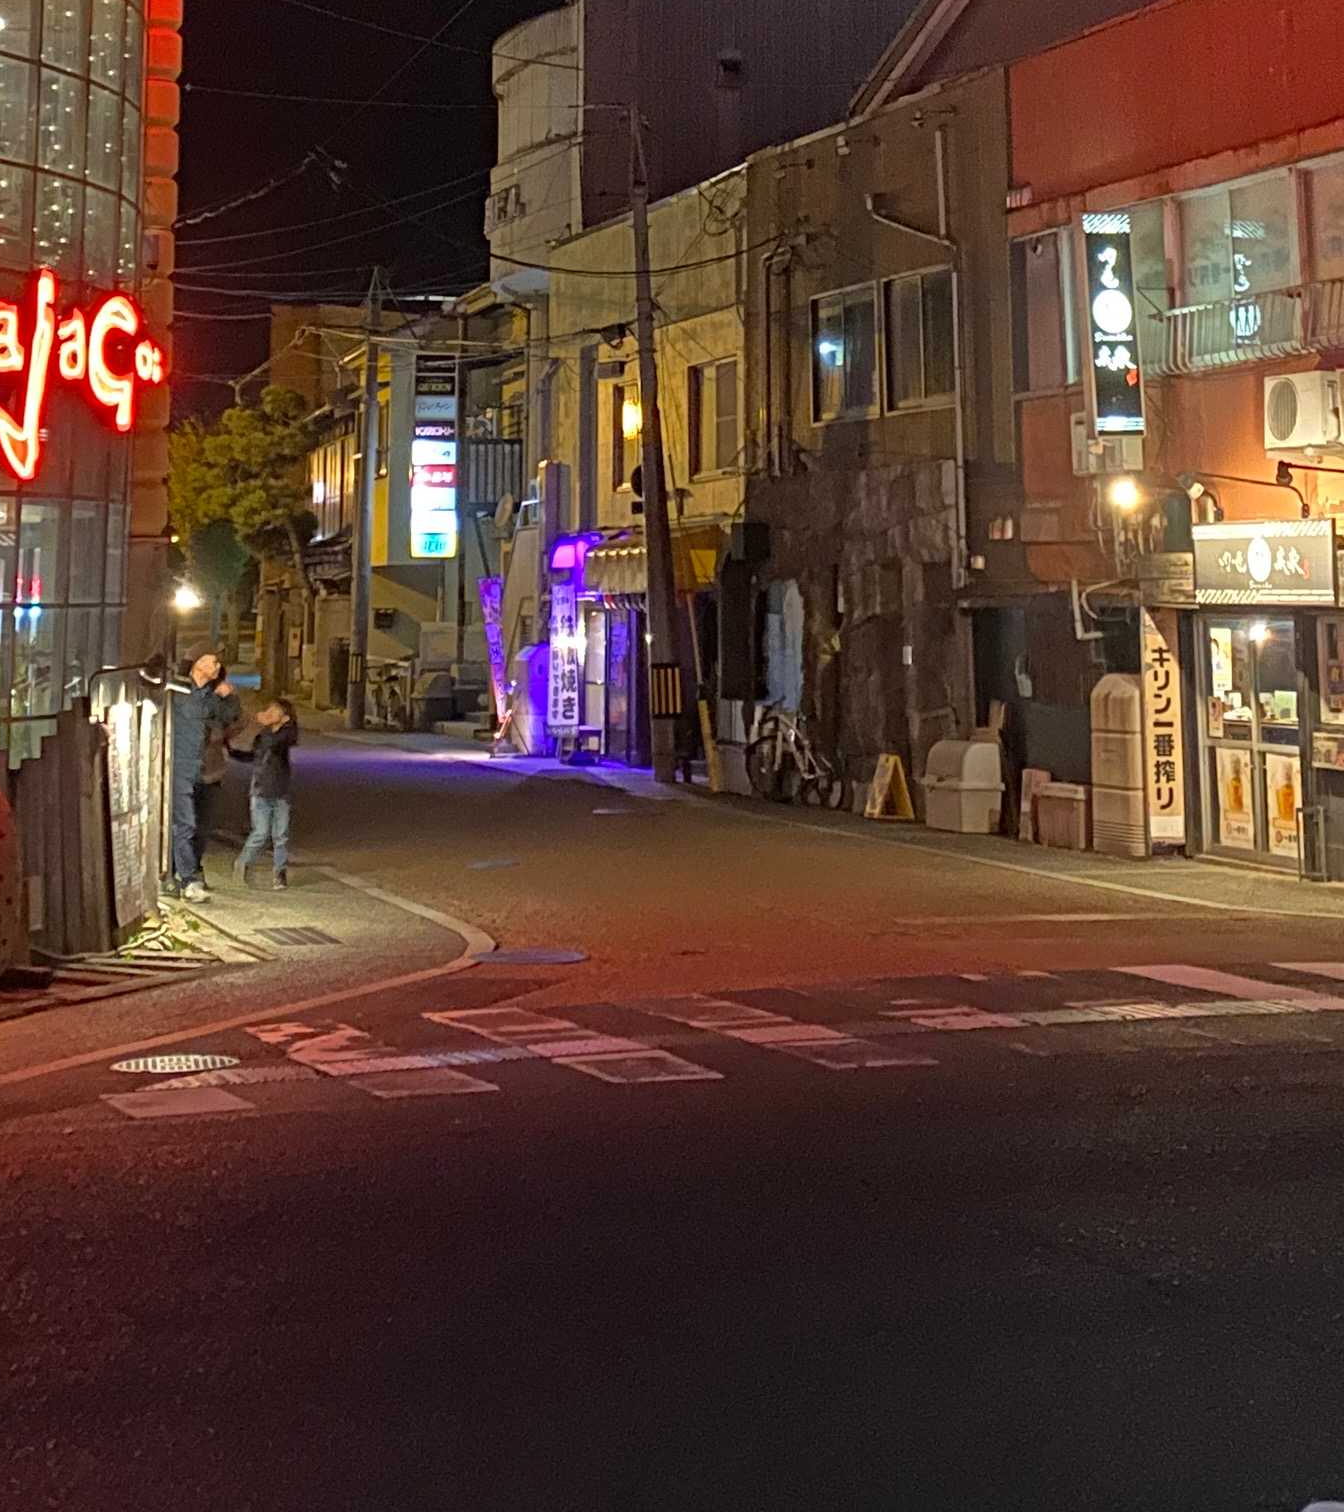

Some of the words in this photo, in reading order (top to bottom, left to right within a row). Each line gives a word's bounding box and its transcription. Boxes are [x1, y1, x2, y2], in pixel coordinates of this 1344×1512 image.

[1150, 646, 1177, 811] キリン一番搾り
